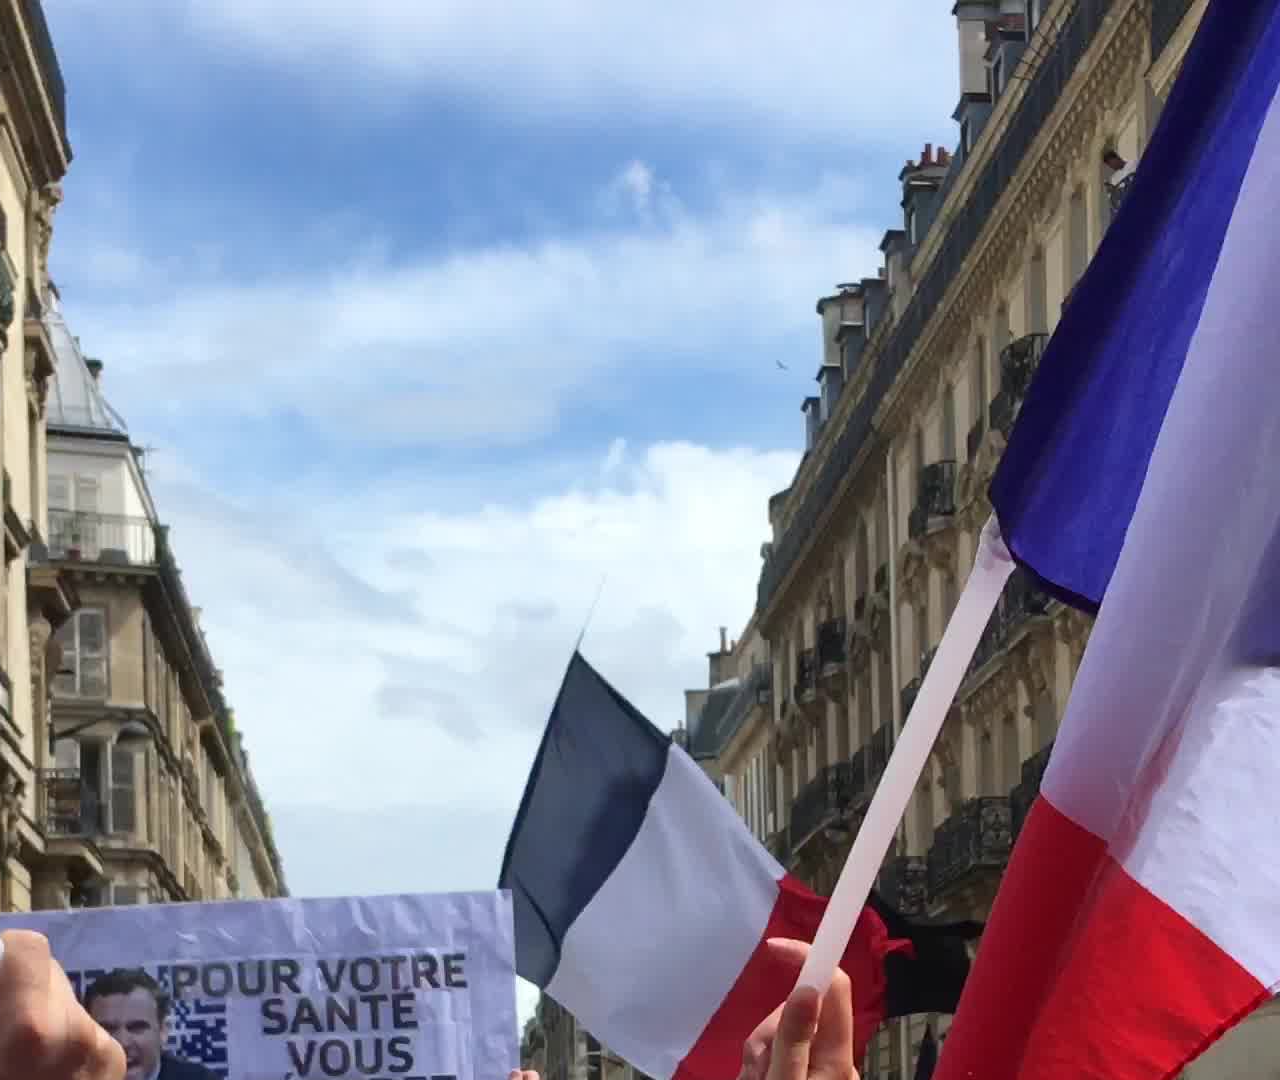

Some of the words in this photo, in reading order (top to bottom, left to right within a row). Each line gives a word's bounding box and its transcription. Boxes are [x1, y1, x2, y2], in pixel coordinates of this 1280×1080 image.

[172, 958, 301, 998] POUR
[317, 952, 468, 993] VOTRE
[261, 985, 419, 1036] SANTÉ
[286, 1035, 415, 1077] VOUS
